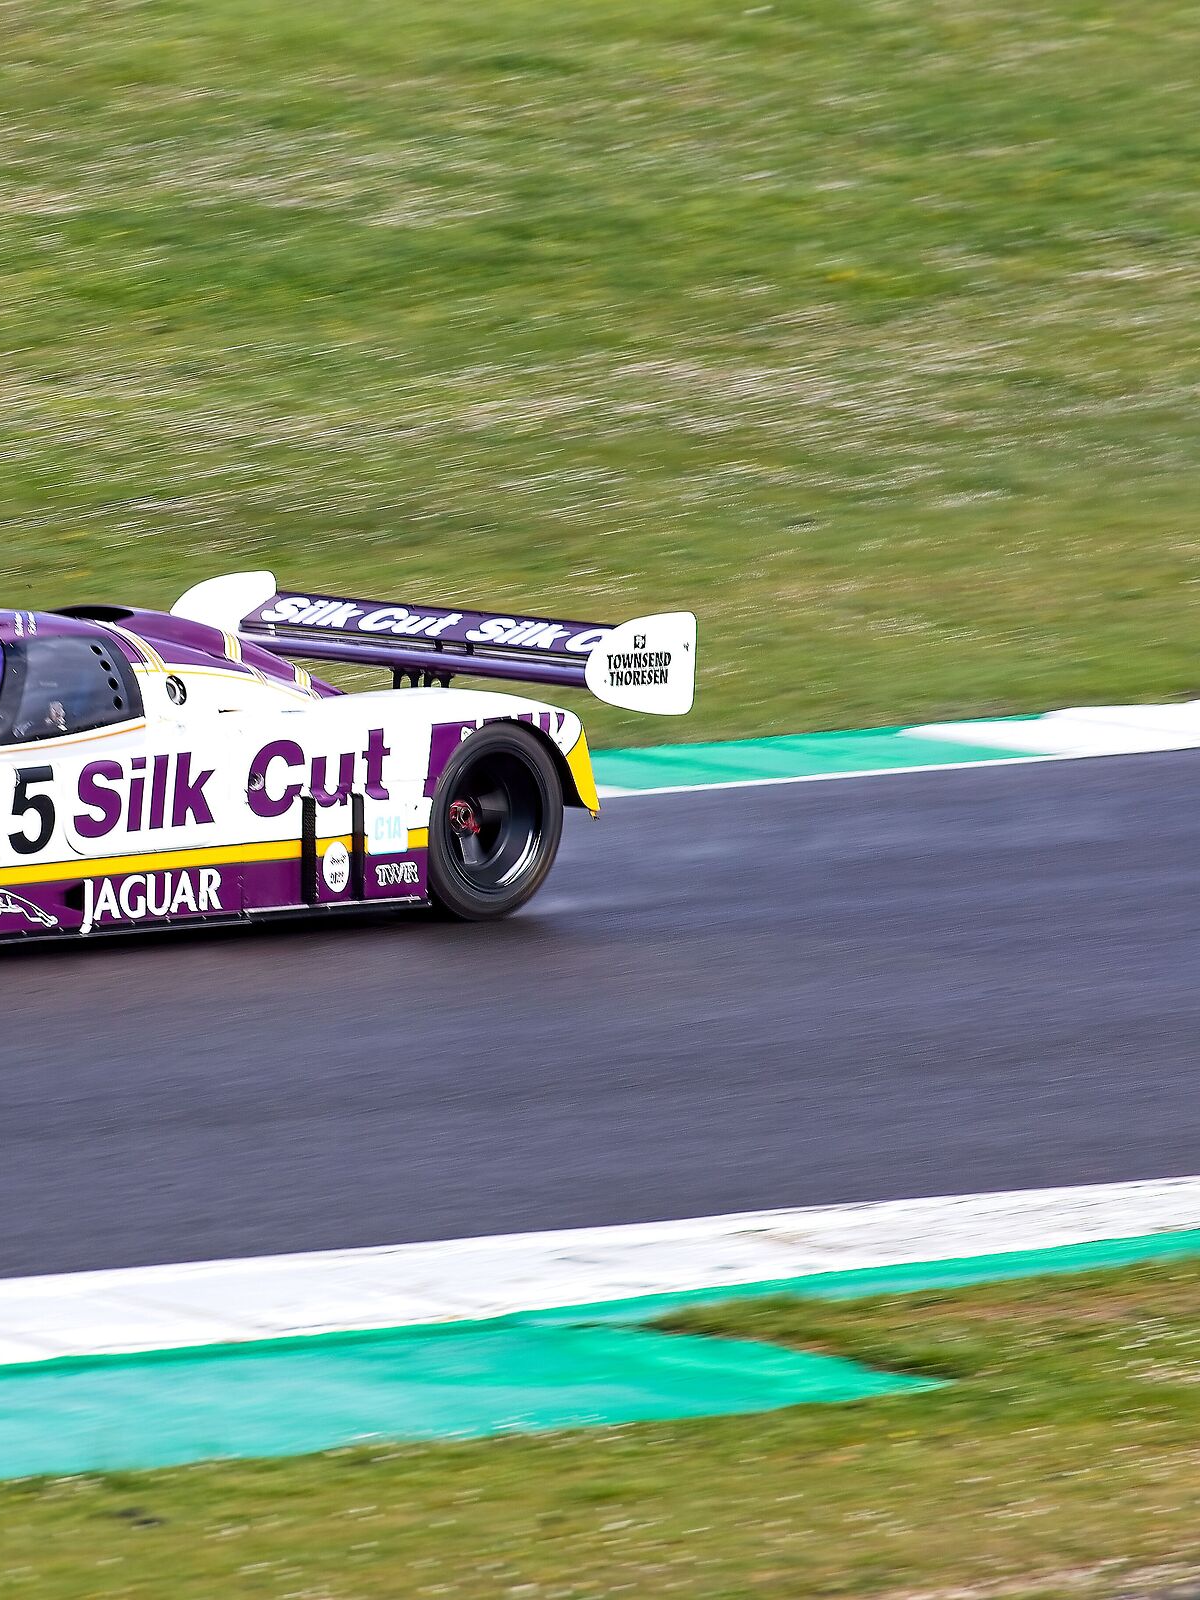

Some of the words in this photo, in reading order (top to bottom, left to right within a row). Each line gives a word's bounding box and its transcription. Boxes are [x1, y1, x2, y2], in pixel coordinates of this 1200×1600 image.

[260, 597, 365, 629] Silk
[357, 607, 463, 641] Cut
[465, 617, 572, 650] Silk
[606, 651, 672, 671] TOWNSEND
[608, 668, 669, 687] THORESEN
[8, 764, 56, 855] 5
[73, 752, 216, 839] Silk
[246, 728, 391, 818] Cut
[79, 868, 223, 934] JAGUAR
